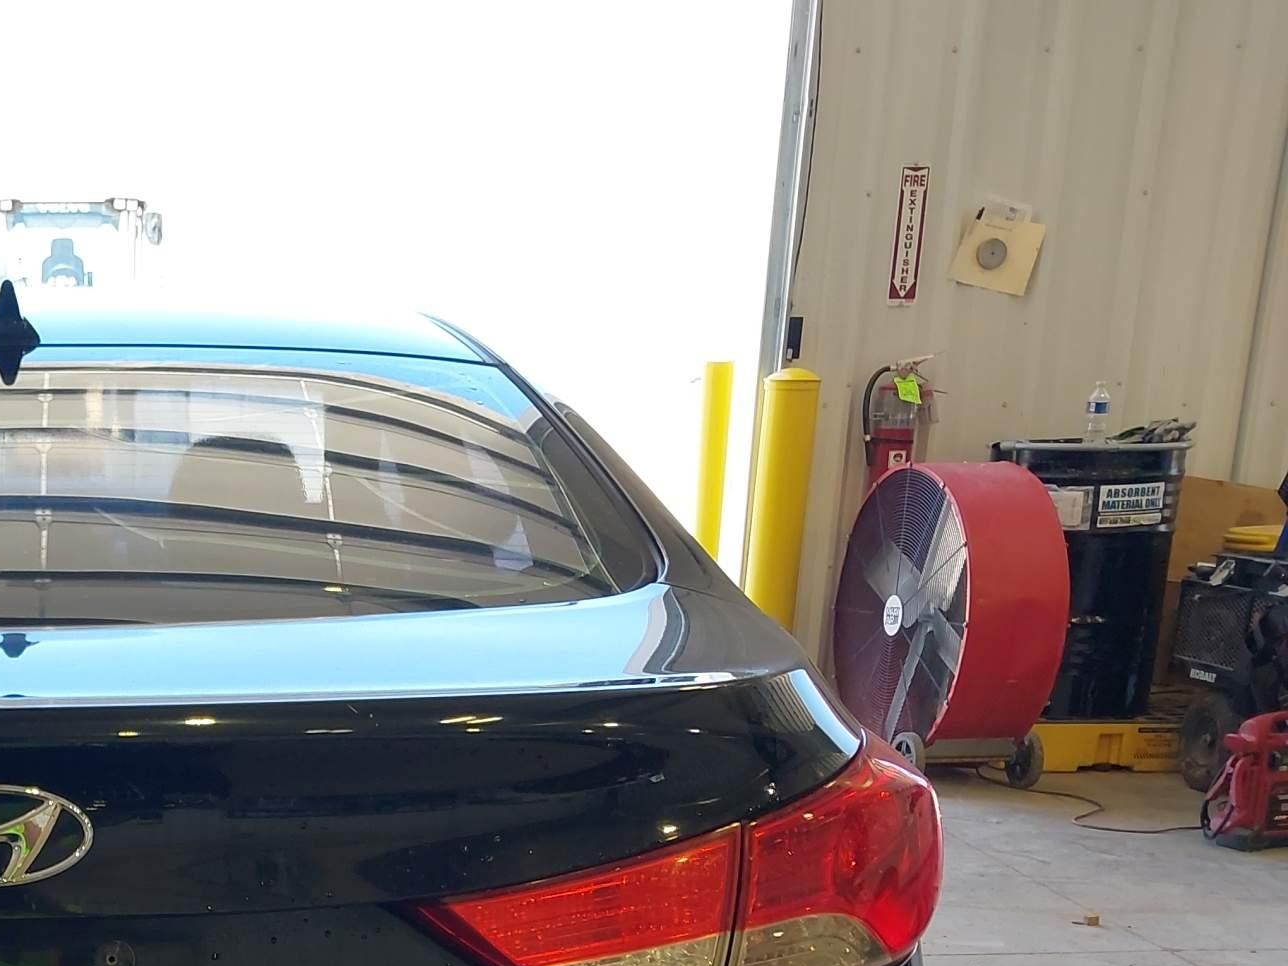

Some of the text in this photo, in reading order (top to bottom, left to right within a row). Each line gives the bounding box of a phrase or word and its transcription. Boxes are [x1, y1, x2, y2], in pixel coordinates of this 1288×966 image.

[903, 174, 927, 188] FIRE
[898, 189, 918, 292] EXTINGUISHER
[1105, 486, 1161, 499] ABSORBENT
[1101, 498, 1143, 510] MATERIAL
[1189, 667, 1217, 684] KOBALT
